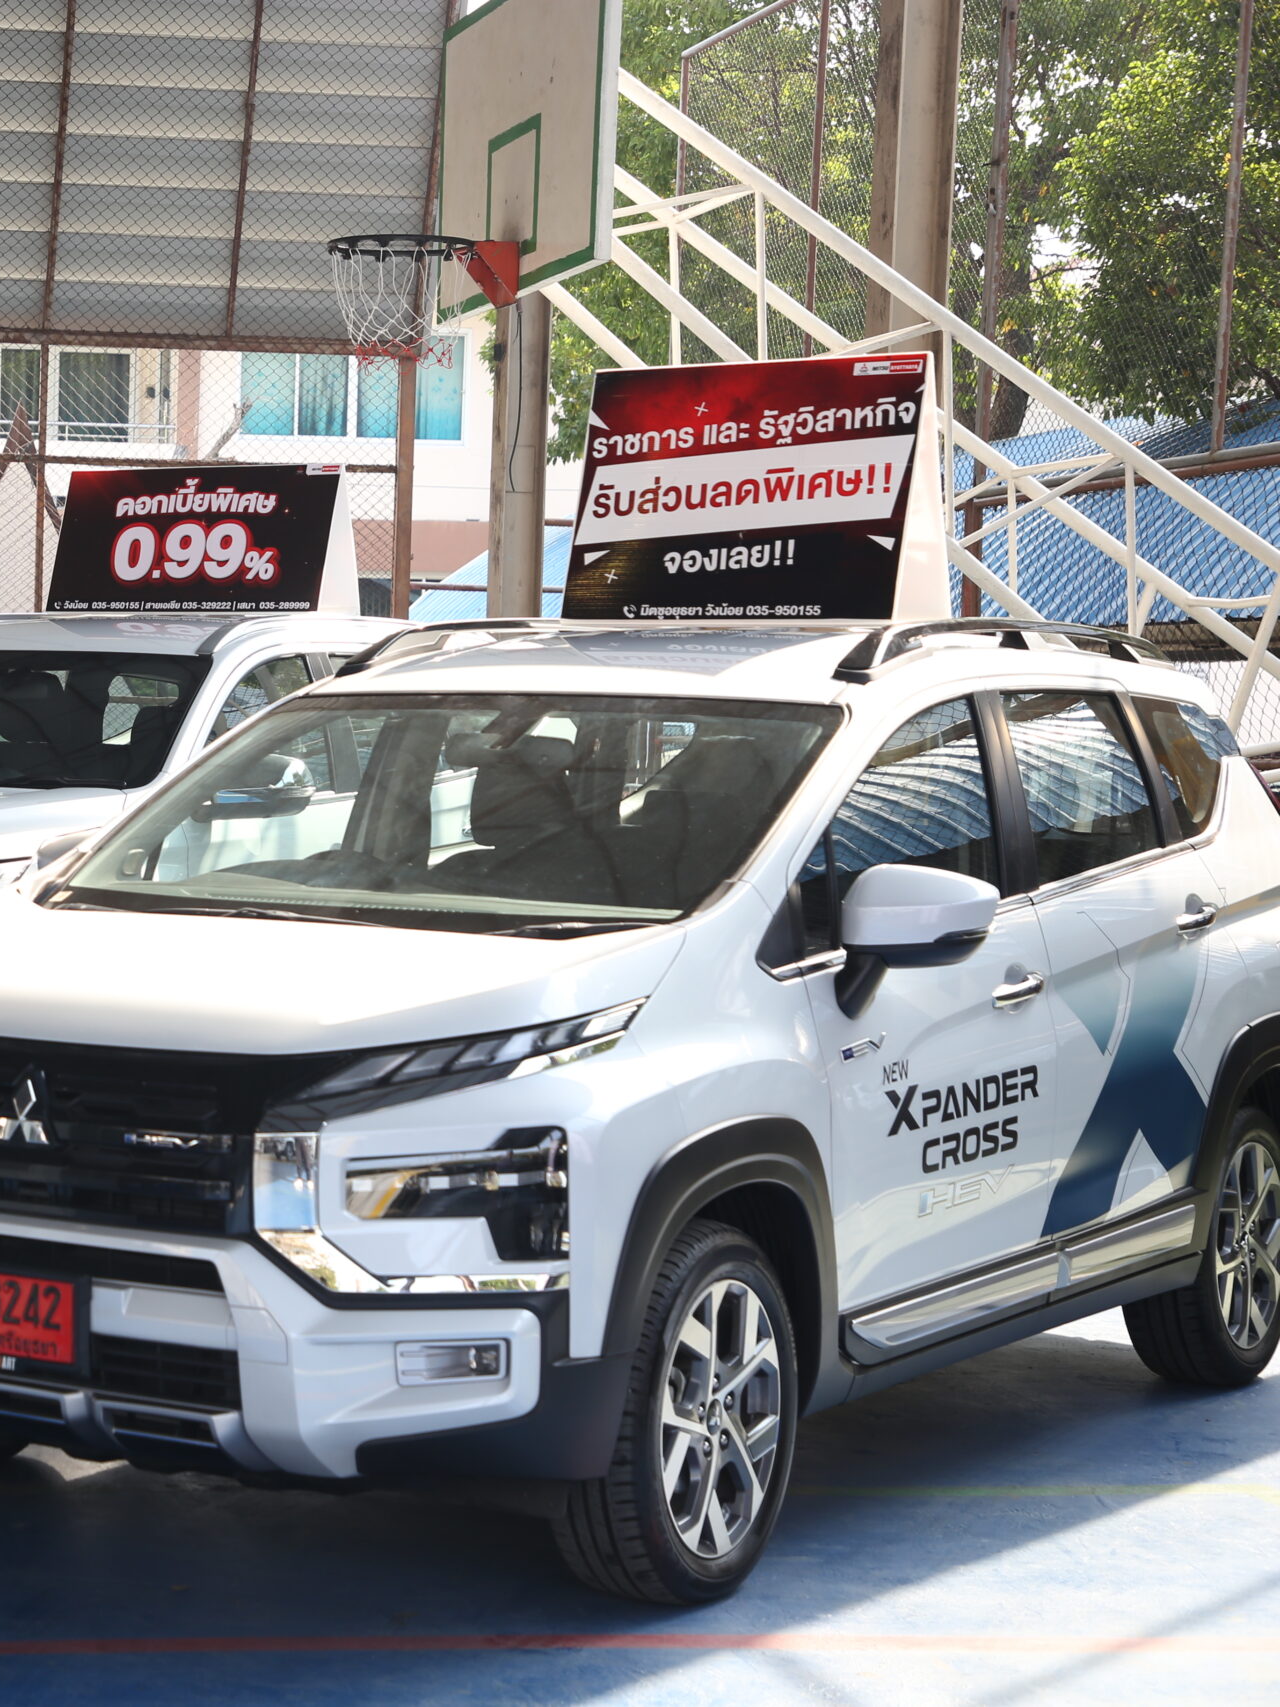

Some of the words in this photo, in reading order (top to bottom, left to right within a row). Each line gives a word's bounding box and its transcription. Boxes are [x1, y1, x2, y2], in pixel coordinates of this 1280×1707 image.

[592, 424, 694, 459] ราชการ
[703, 421, 749, 446] และ
[759, 397, 916, 445] รัฐวิสาหกิจ
[115, 478, 276, 517] ดอกเบี้ยพิเศษ
[592, 462, 892, 519] รับส่วนลดพิเศษ!!
[113, 523, 275, 581] 0.99%
[663, 539, 795, 574] จองเลย!!
[91, 601, 140, 609] 035-950155
[182, 601, 231, 609] 035-329222
[260, 601, 310, 609] 035-289999
[705, 602, 744, 616] วังน้อย
[746, 605, 821, 616] 035-950155
[883, 1059, 909, 1085] NEW
[884, 1064, 1040, 1137] XPANDER
[922, 1115, 1019, 1174] CROSS
[918, 1164, 1015, 1218] HEV
